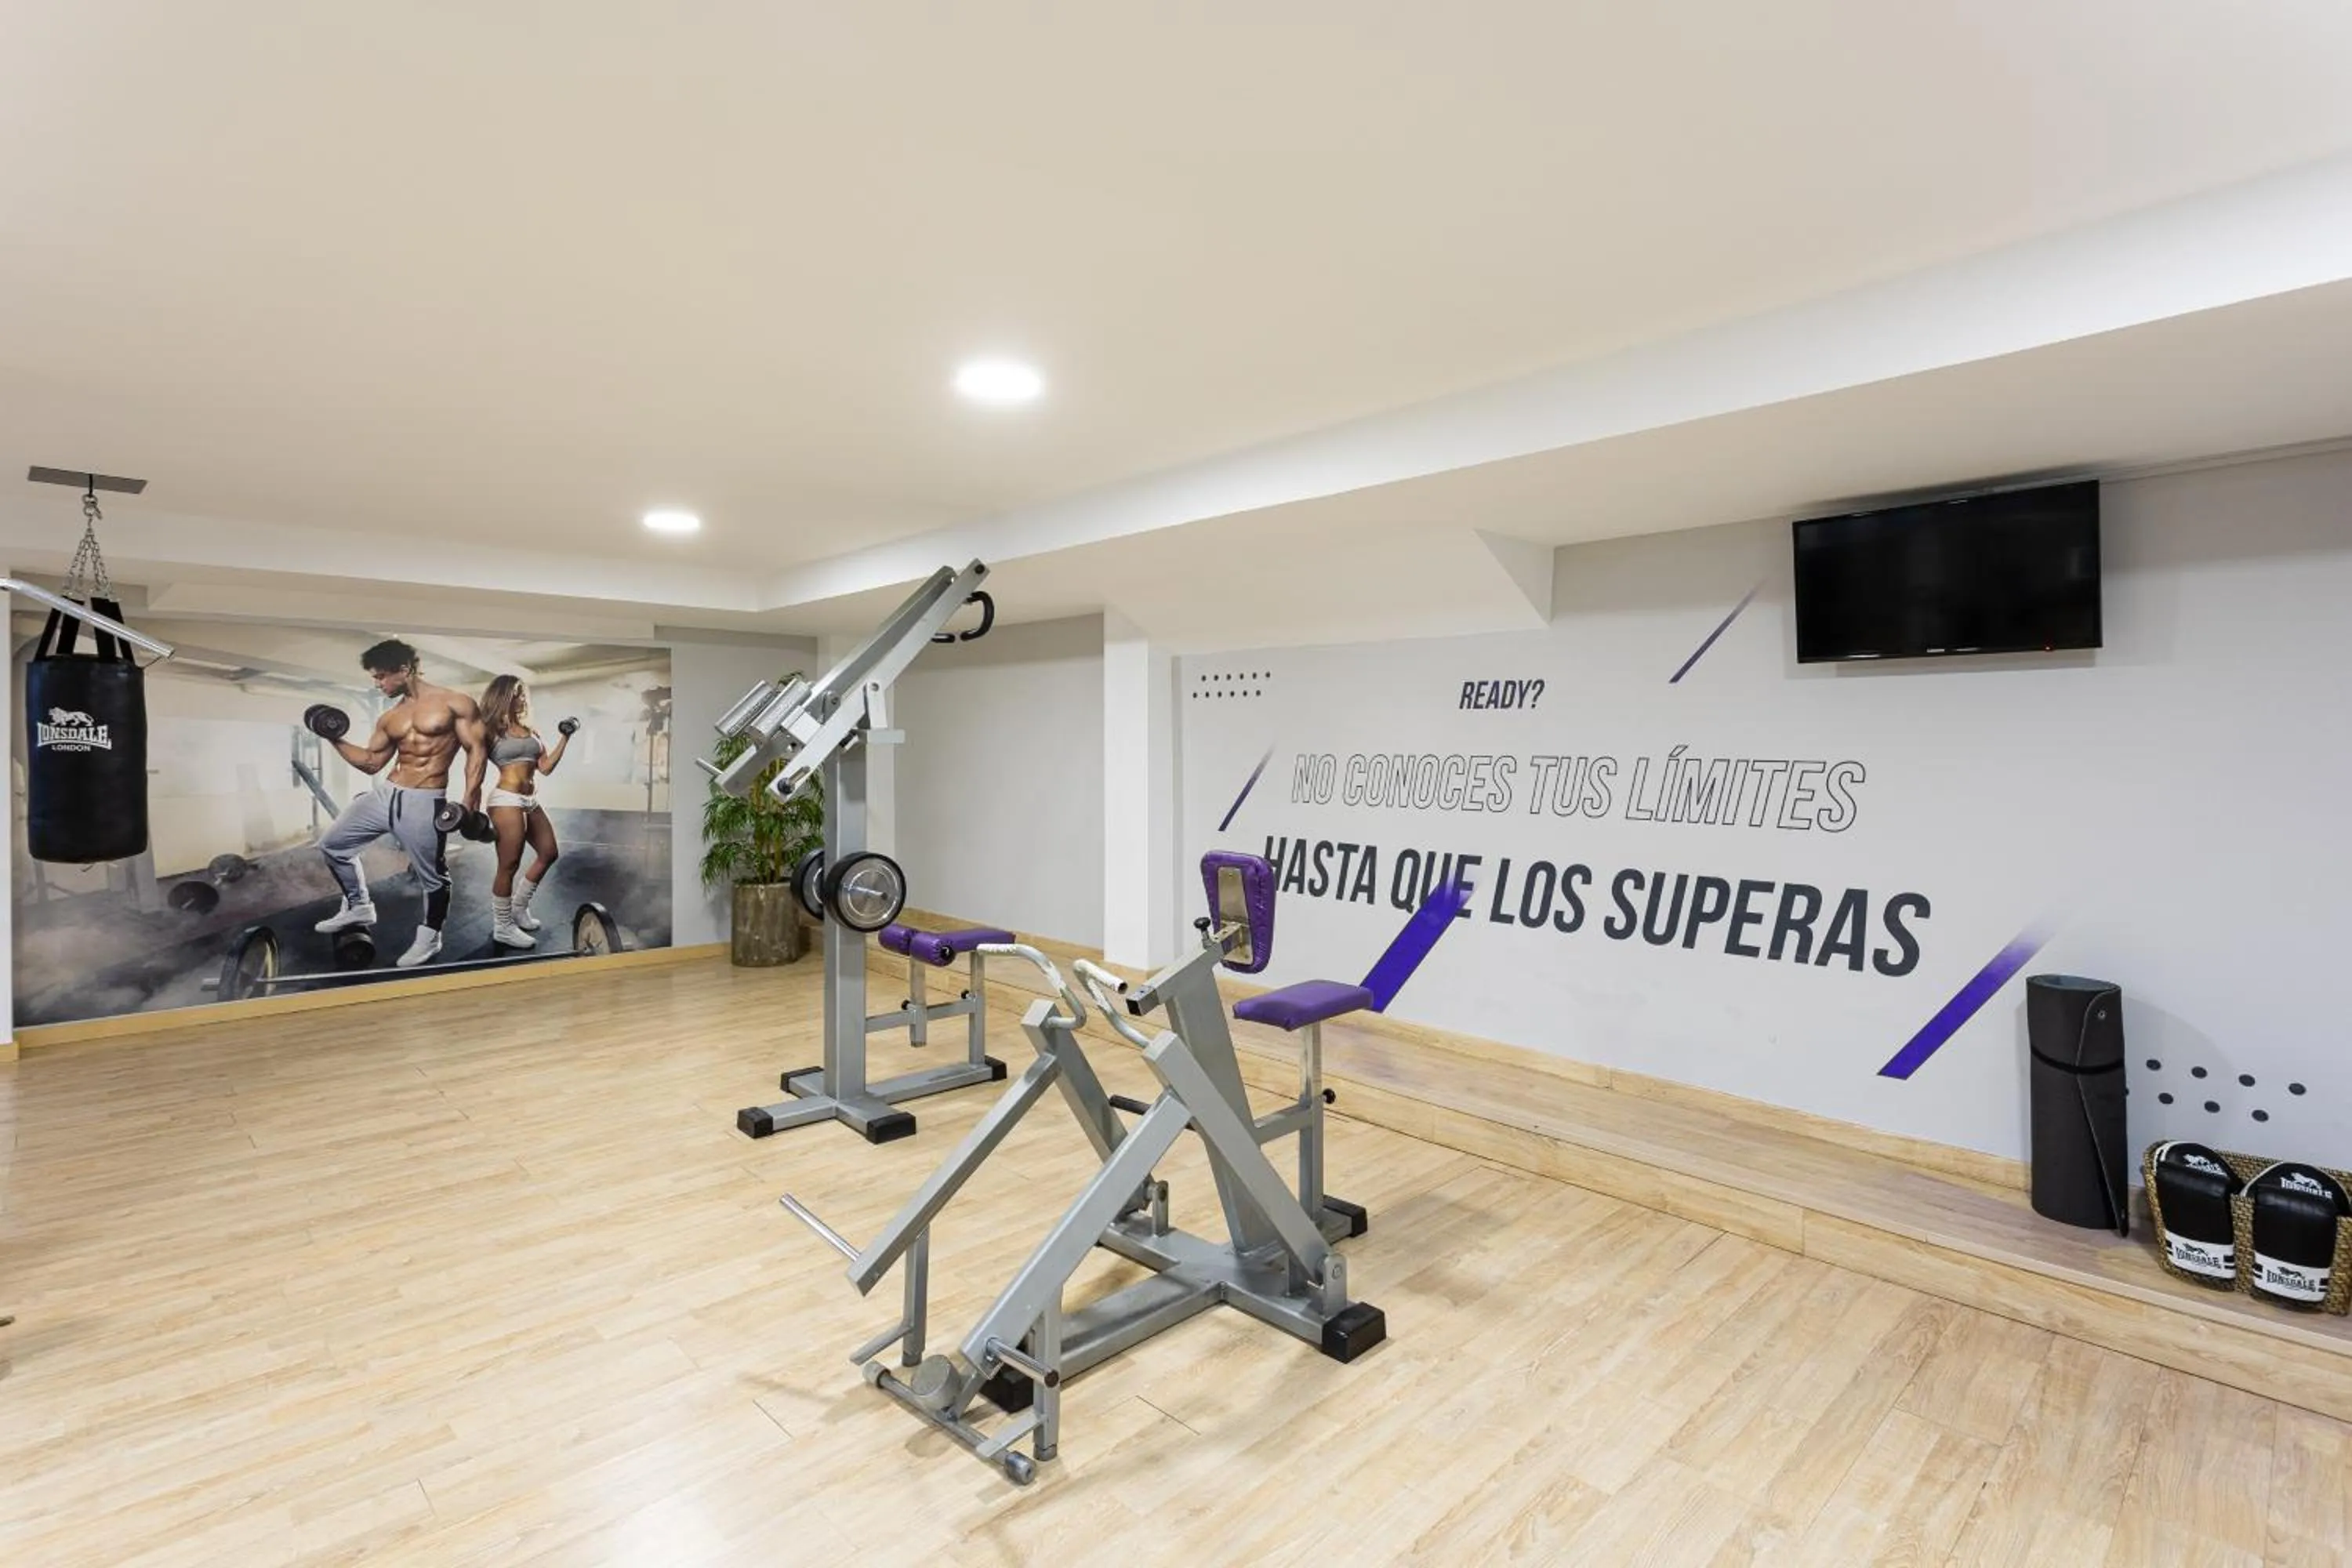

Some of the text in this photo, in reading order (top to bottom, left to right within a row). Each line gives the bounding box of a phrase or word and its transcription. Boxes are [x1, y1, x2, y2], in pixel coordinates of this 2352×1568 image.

[1459, 680, 1544, 710] READY?
[37, 722, 111, 750] LONSDALE
[1292, 744, 1866, 833] NO CONOCES TUS LÍMITES
[1265, 836, 1931, 978] HASTA QUE LOS SUPERAS
